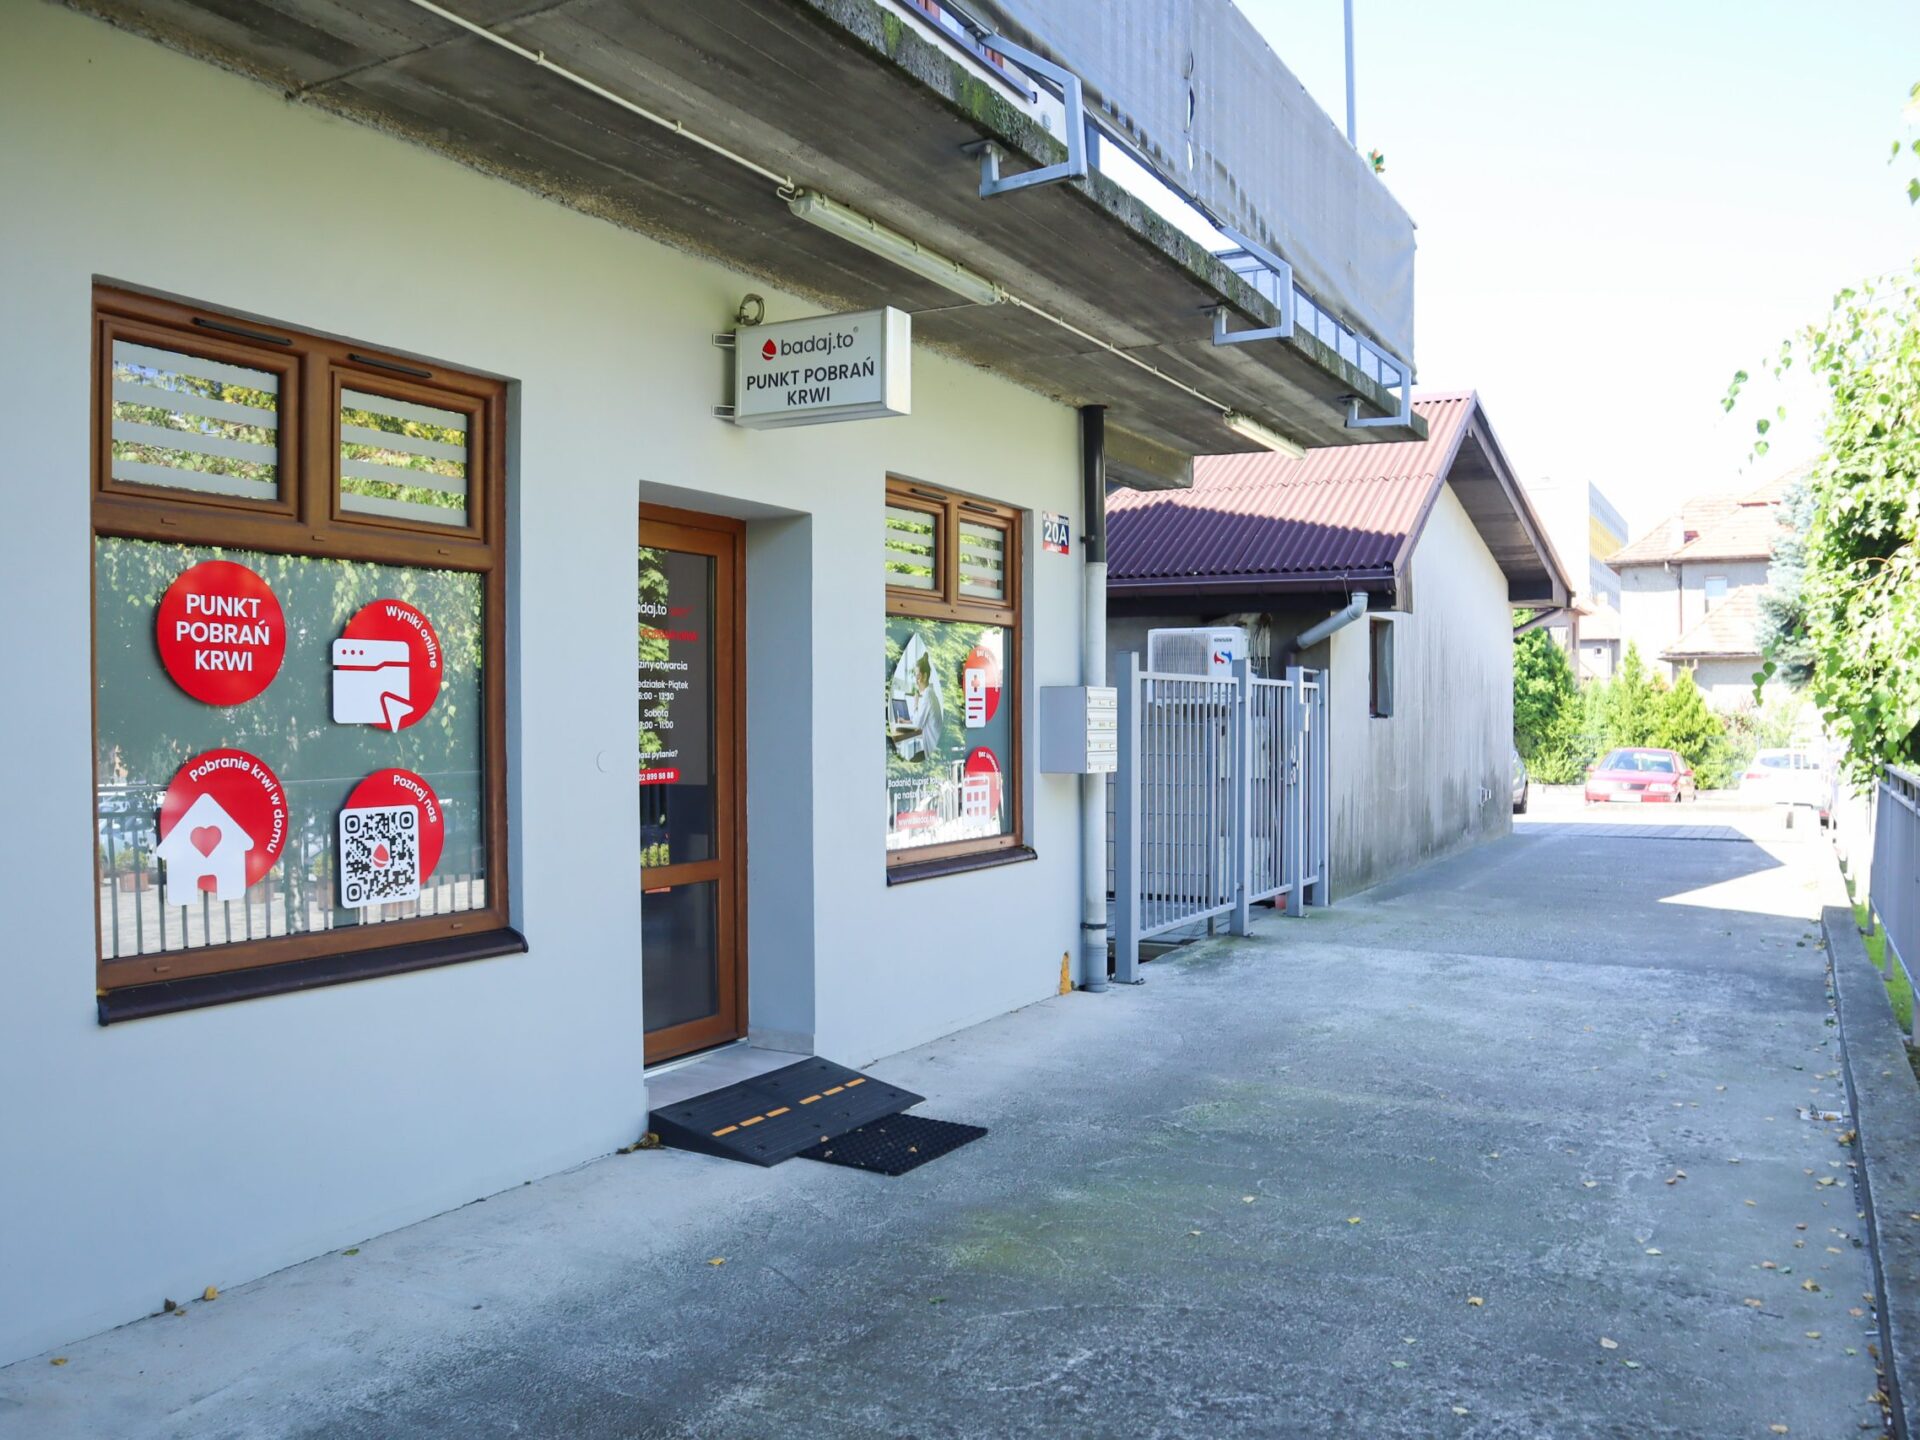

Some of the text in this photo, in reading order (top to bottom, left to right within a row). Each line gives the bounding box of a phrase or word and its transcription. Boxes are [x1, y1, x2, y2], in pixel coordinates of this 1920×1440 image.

[746, 356, 875, 391] PUNKT POBRAŃ
[787, 387, 830, 406] KRWI
[1044, 521, 1068, 546] 20A
[186, 593, 261, 618] PUNKT
[638, 601, 668, 618] daj.to
[176, 619, 270, 646] POBRAŃ
[385, 605, 437, 669] Wyniki online
[195, 649, 253, 672] KRWI
[655, 660, 688, 671] otwarcia
[643, 708, 669, 718] Sobota
[189, 756, 285, 854] Pobranie krwi w domu
[393, 774, 437, 823] Poznaj nas
